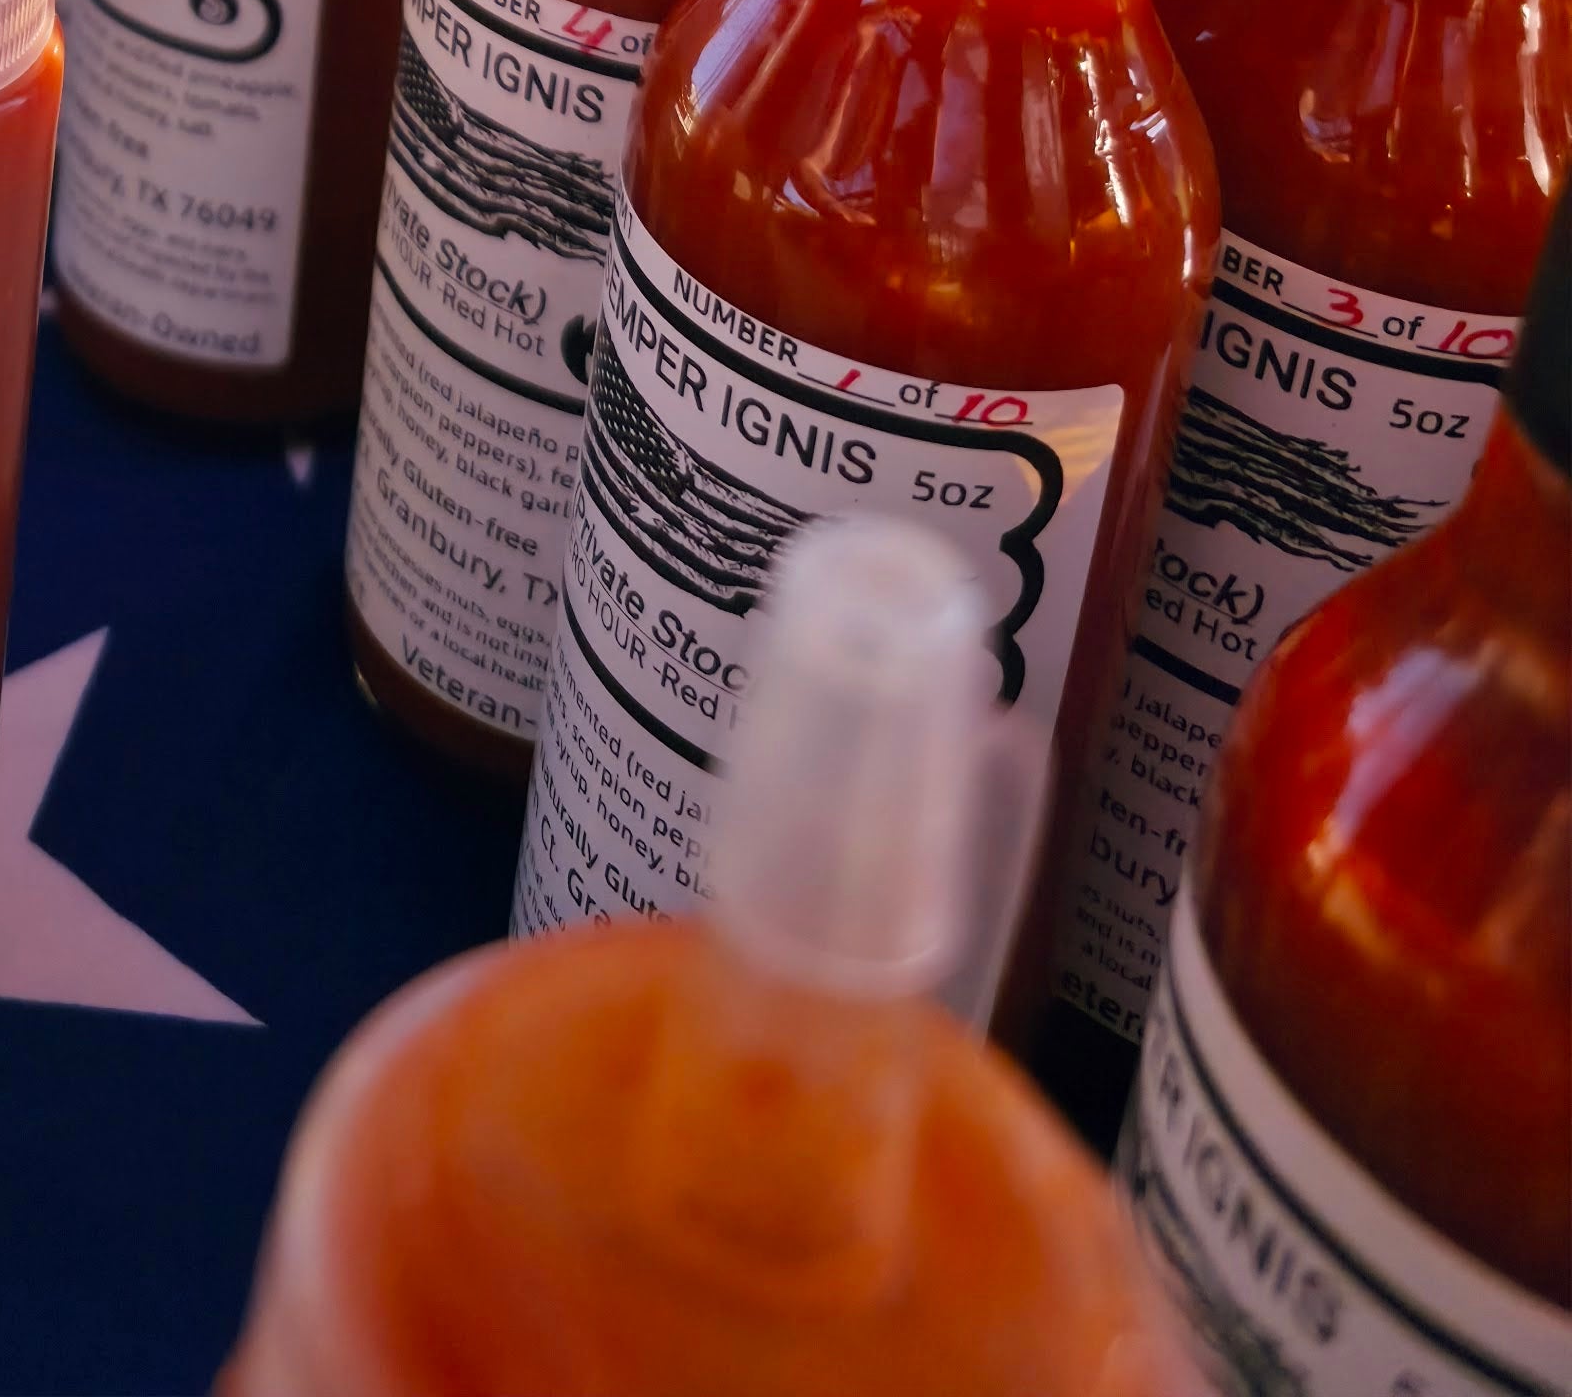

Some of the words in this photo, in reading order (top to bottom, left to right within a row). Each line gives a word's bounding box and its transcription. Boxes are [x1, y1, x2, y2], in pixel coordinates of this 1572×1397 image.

[562, 5, 613, 56] 4
[483, 42, 605, 124] IGNIS
[435, 238, 547, 326] Stock)
[1222, 244, 1284, 297] BER
[1328, 288, 1364, 329] 3
[1382, 314, 1423, 345] of
[1438, 319, 1517, 358] 10
[494, 312, 545, 358] Hot
[604, 240, 708, 411] SEMPER
[719, 383, 878, 486] IGNIS
[911, 470, 995, 510] 5oz
[672, 266, 800, 367] NUMBER
[898, 380, 940, 409] of
[954, 393, 1030, 428] 10
[1199, 311, 1358, 411] IGNIS
[1388, 398, 1471, 439] 5oz
[438, 414, 542, 483] peppers),
[456, 391, 558, 456] jalapeño
[377, 467, 508, 594] Granbury,
[403, 456, 540, 558] Gluten-free
[456, 454, 513, 500] black
[519, 490, 571, 521] garl
[442, 629, 486, 669] local
[475, 629, 509, 655] not
[588, 578, 647, 669] HOUR
[651, 609, 751, 691] Stoc
[1193, 609, 1257, 661] Hot
[401, 634, 538, 729] Veteran-
[556, 635, 622, 760] ermented
[626, 750, 672, 802] (red
[1136, 693, 1224, 750] jalape
[556, 729, 591, 804] syrup,
[596, 793, 665, 875] honey,
[572, 724, 646, 820] scorpion
